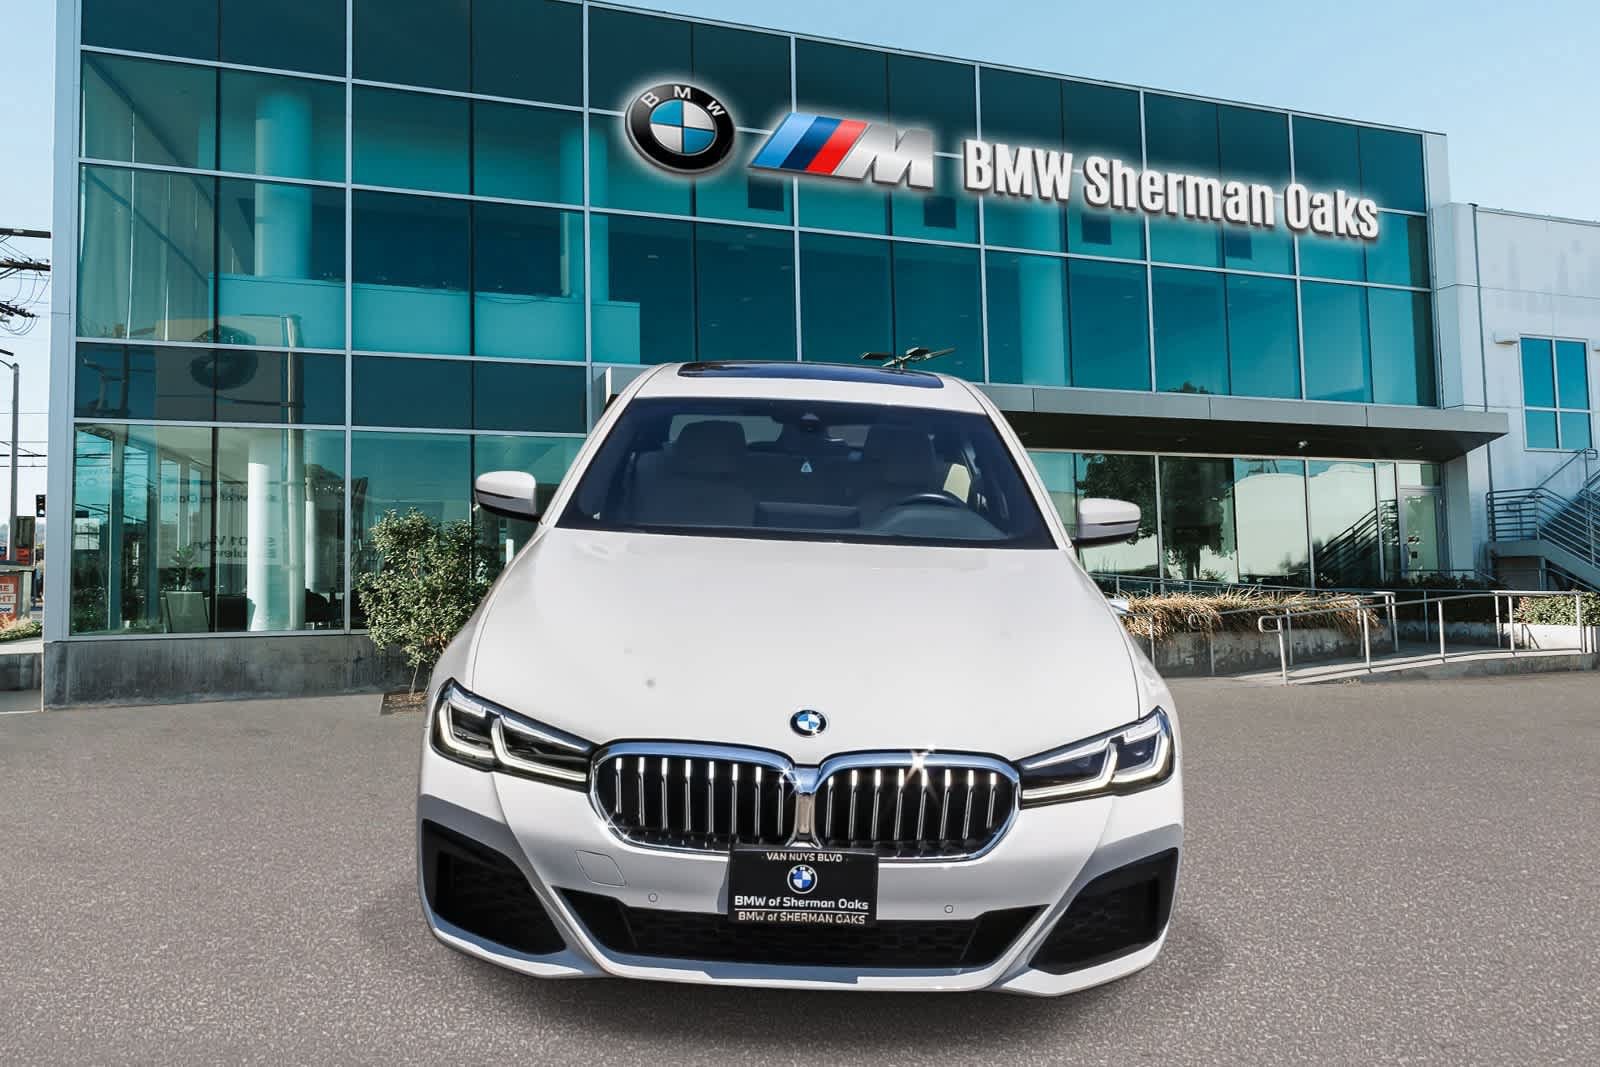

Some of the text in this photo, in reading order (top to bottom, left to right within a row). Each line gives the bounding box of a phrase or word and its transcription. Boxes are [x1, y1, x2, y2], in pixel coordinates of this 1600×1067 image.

[640, 86, 726, 117] BMW
[963, 139, 1380, 242] BMW Sherman Oaks
[766, 852, 843, 862] VAN NUYS BLVD
[734, 895, 870, 910] BMW of Sherman Oaks
[738, 911, 867, 925] BMW of SHERMAN OAKS
